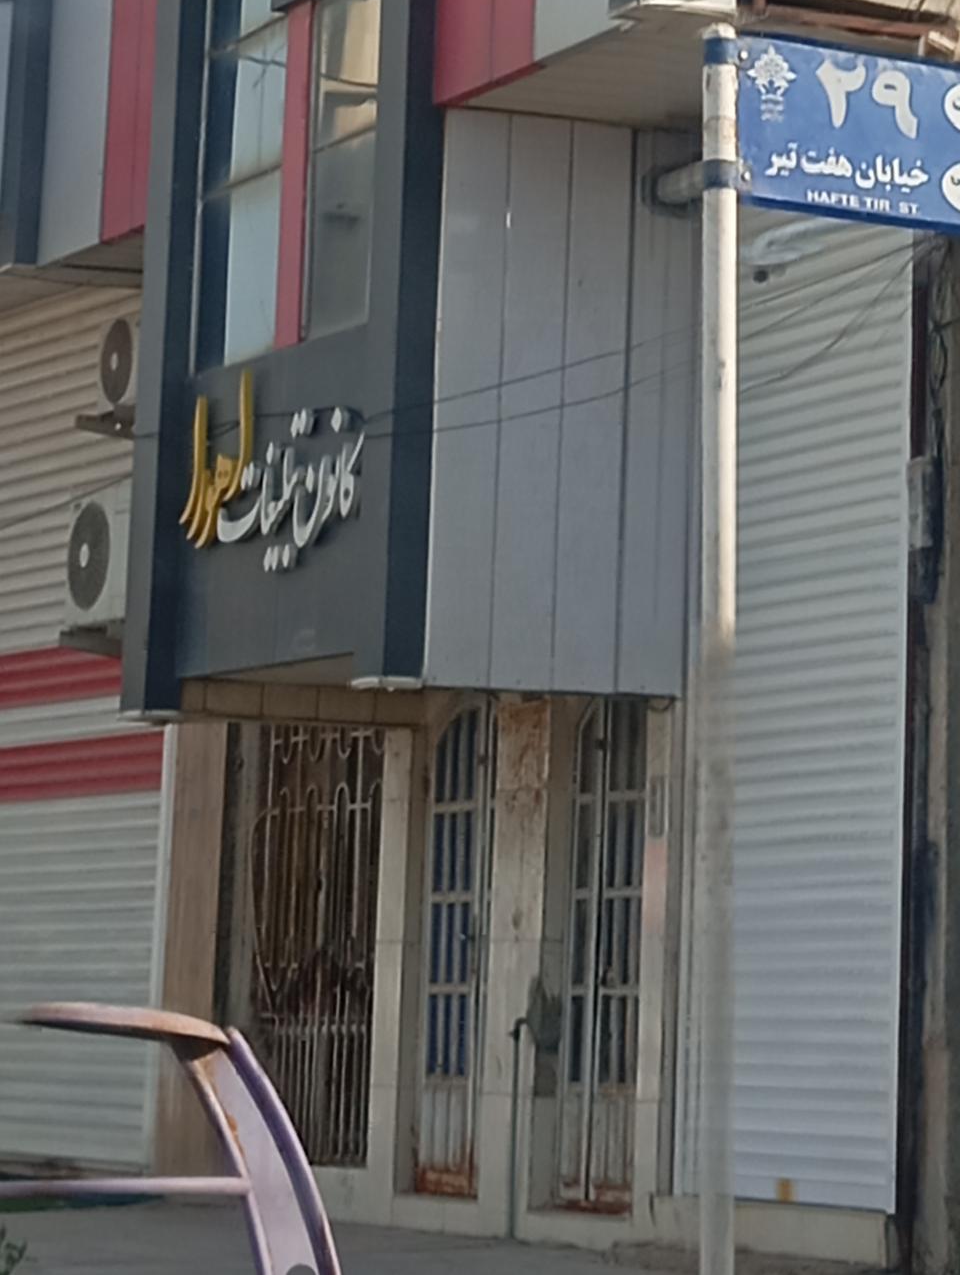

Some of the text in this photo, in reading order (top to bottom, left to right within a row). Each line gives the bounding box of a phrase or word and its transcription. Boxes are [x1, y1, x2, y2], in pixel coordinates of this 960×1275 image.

[815, 55, 918, 139] ۲۹
[764, 142, 929, 193] خیابان هفت تیر
[806, 190, 860, 209] HAFTE
[864, 197, 891, 213] TIR
[217, 407, 305, 573] تبلیغات
[292, 407, 365, 549] کانون
